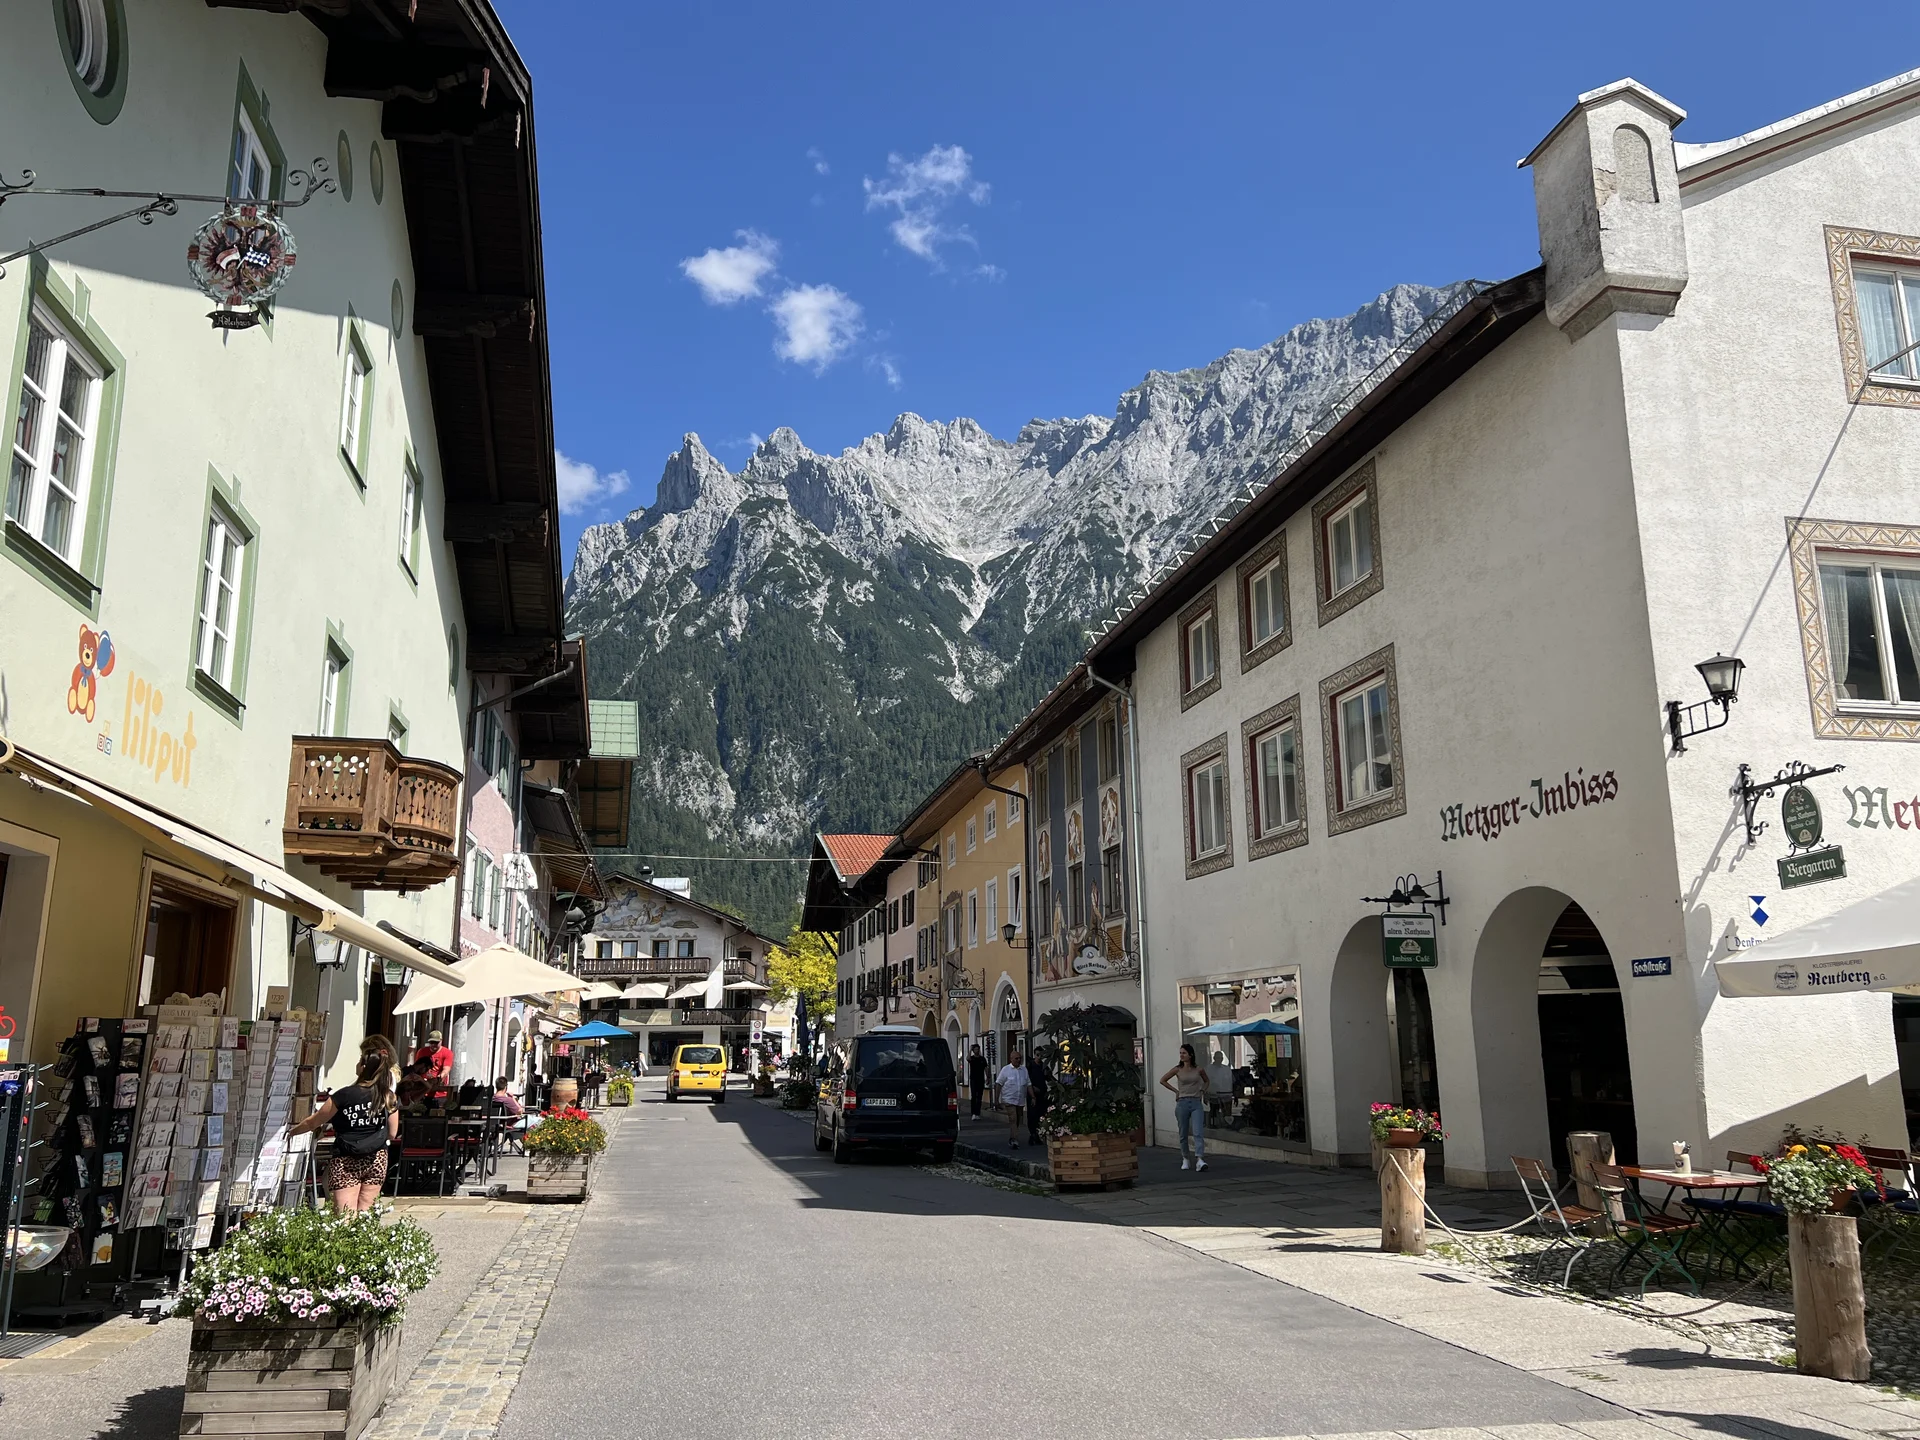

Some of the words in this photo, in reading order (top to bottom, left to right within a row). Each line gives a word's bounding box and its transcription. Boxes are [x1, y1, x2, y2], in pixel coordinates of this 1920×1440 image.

[121, 670, 197, 788] liliput
[1440, 766, 1618, 842] Metzger-Imbiss
[1786, 858, 1837, 878] Biergarten
[1402, 919, 1415, 927] Zum
[1404, 928, 1431, 936] Rathaus
[1812, 959, 1863, 969] KLOSTERBRAUEREI
[1807, 970, 1871, 986] Reutberg
[347, 1112, 358, 1120] TO
[350, 1116, 386, 1127] FRONT
